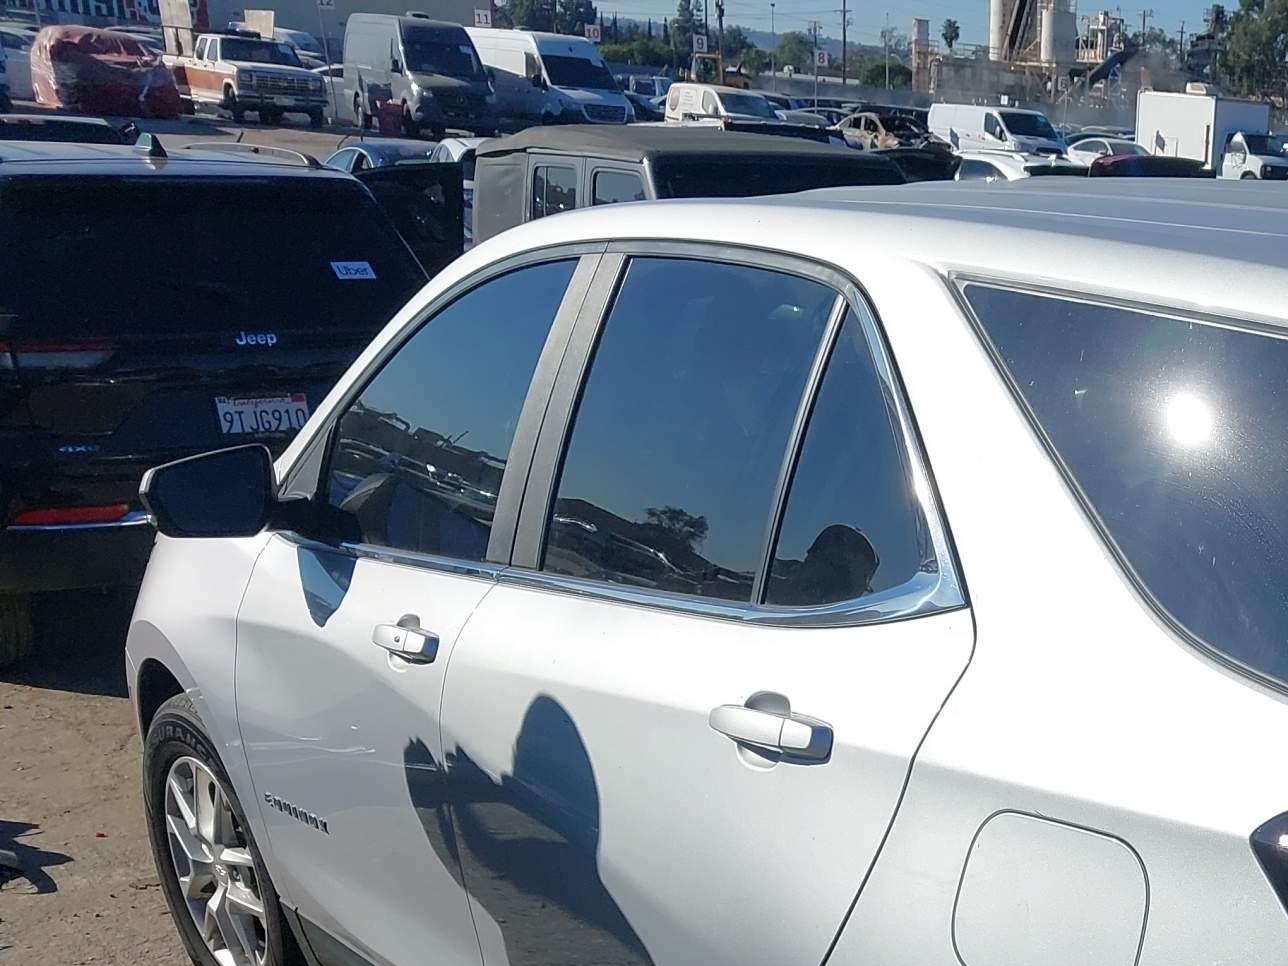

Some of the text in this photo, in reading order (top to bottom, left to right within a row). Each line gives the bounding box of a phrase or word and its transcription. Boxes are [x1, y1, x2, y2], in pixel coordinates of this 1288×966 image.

[476, 13, 490, 24] 11
[586, 27, 600, 38] 10
[696, 37, 705, 49] 9
[817, 52, 825, 64] 8
[336, 264, 370, 276] Uber
[235, 331, 278, 346] Jeep
[222, 407, 306, 433] 9TJG910
